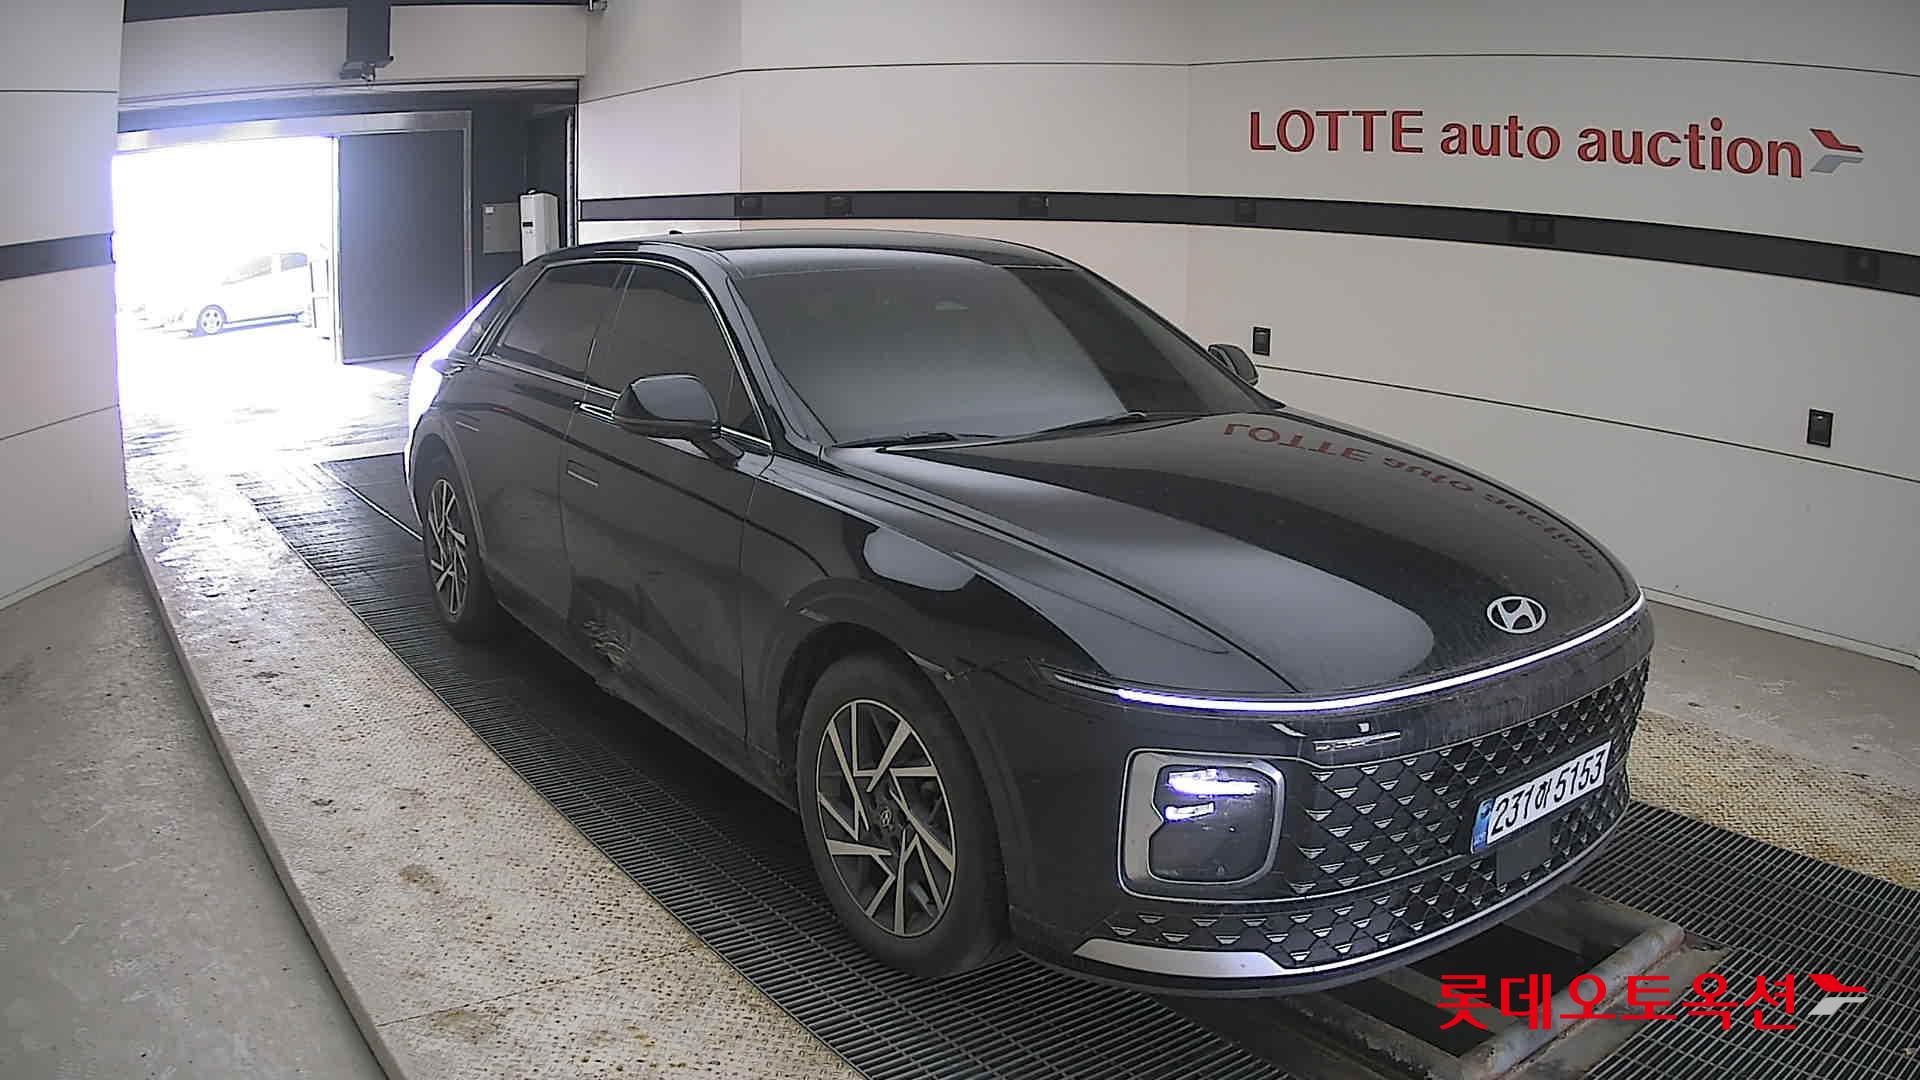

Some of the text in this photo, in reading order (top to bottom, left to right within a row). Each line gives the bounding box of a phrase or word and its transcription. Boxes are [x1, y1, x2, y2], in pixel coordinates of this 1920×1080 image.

[1249, 110, 1804, 179] LOTTE auto auction
[1554, 749, 1606, 803] 5153
